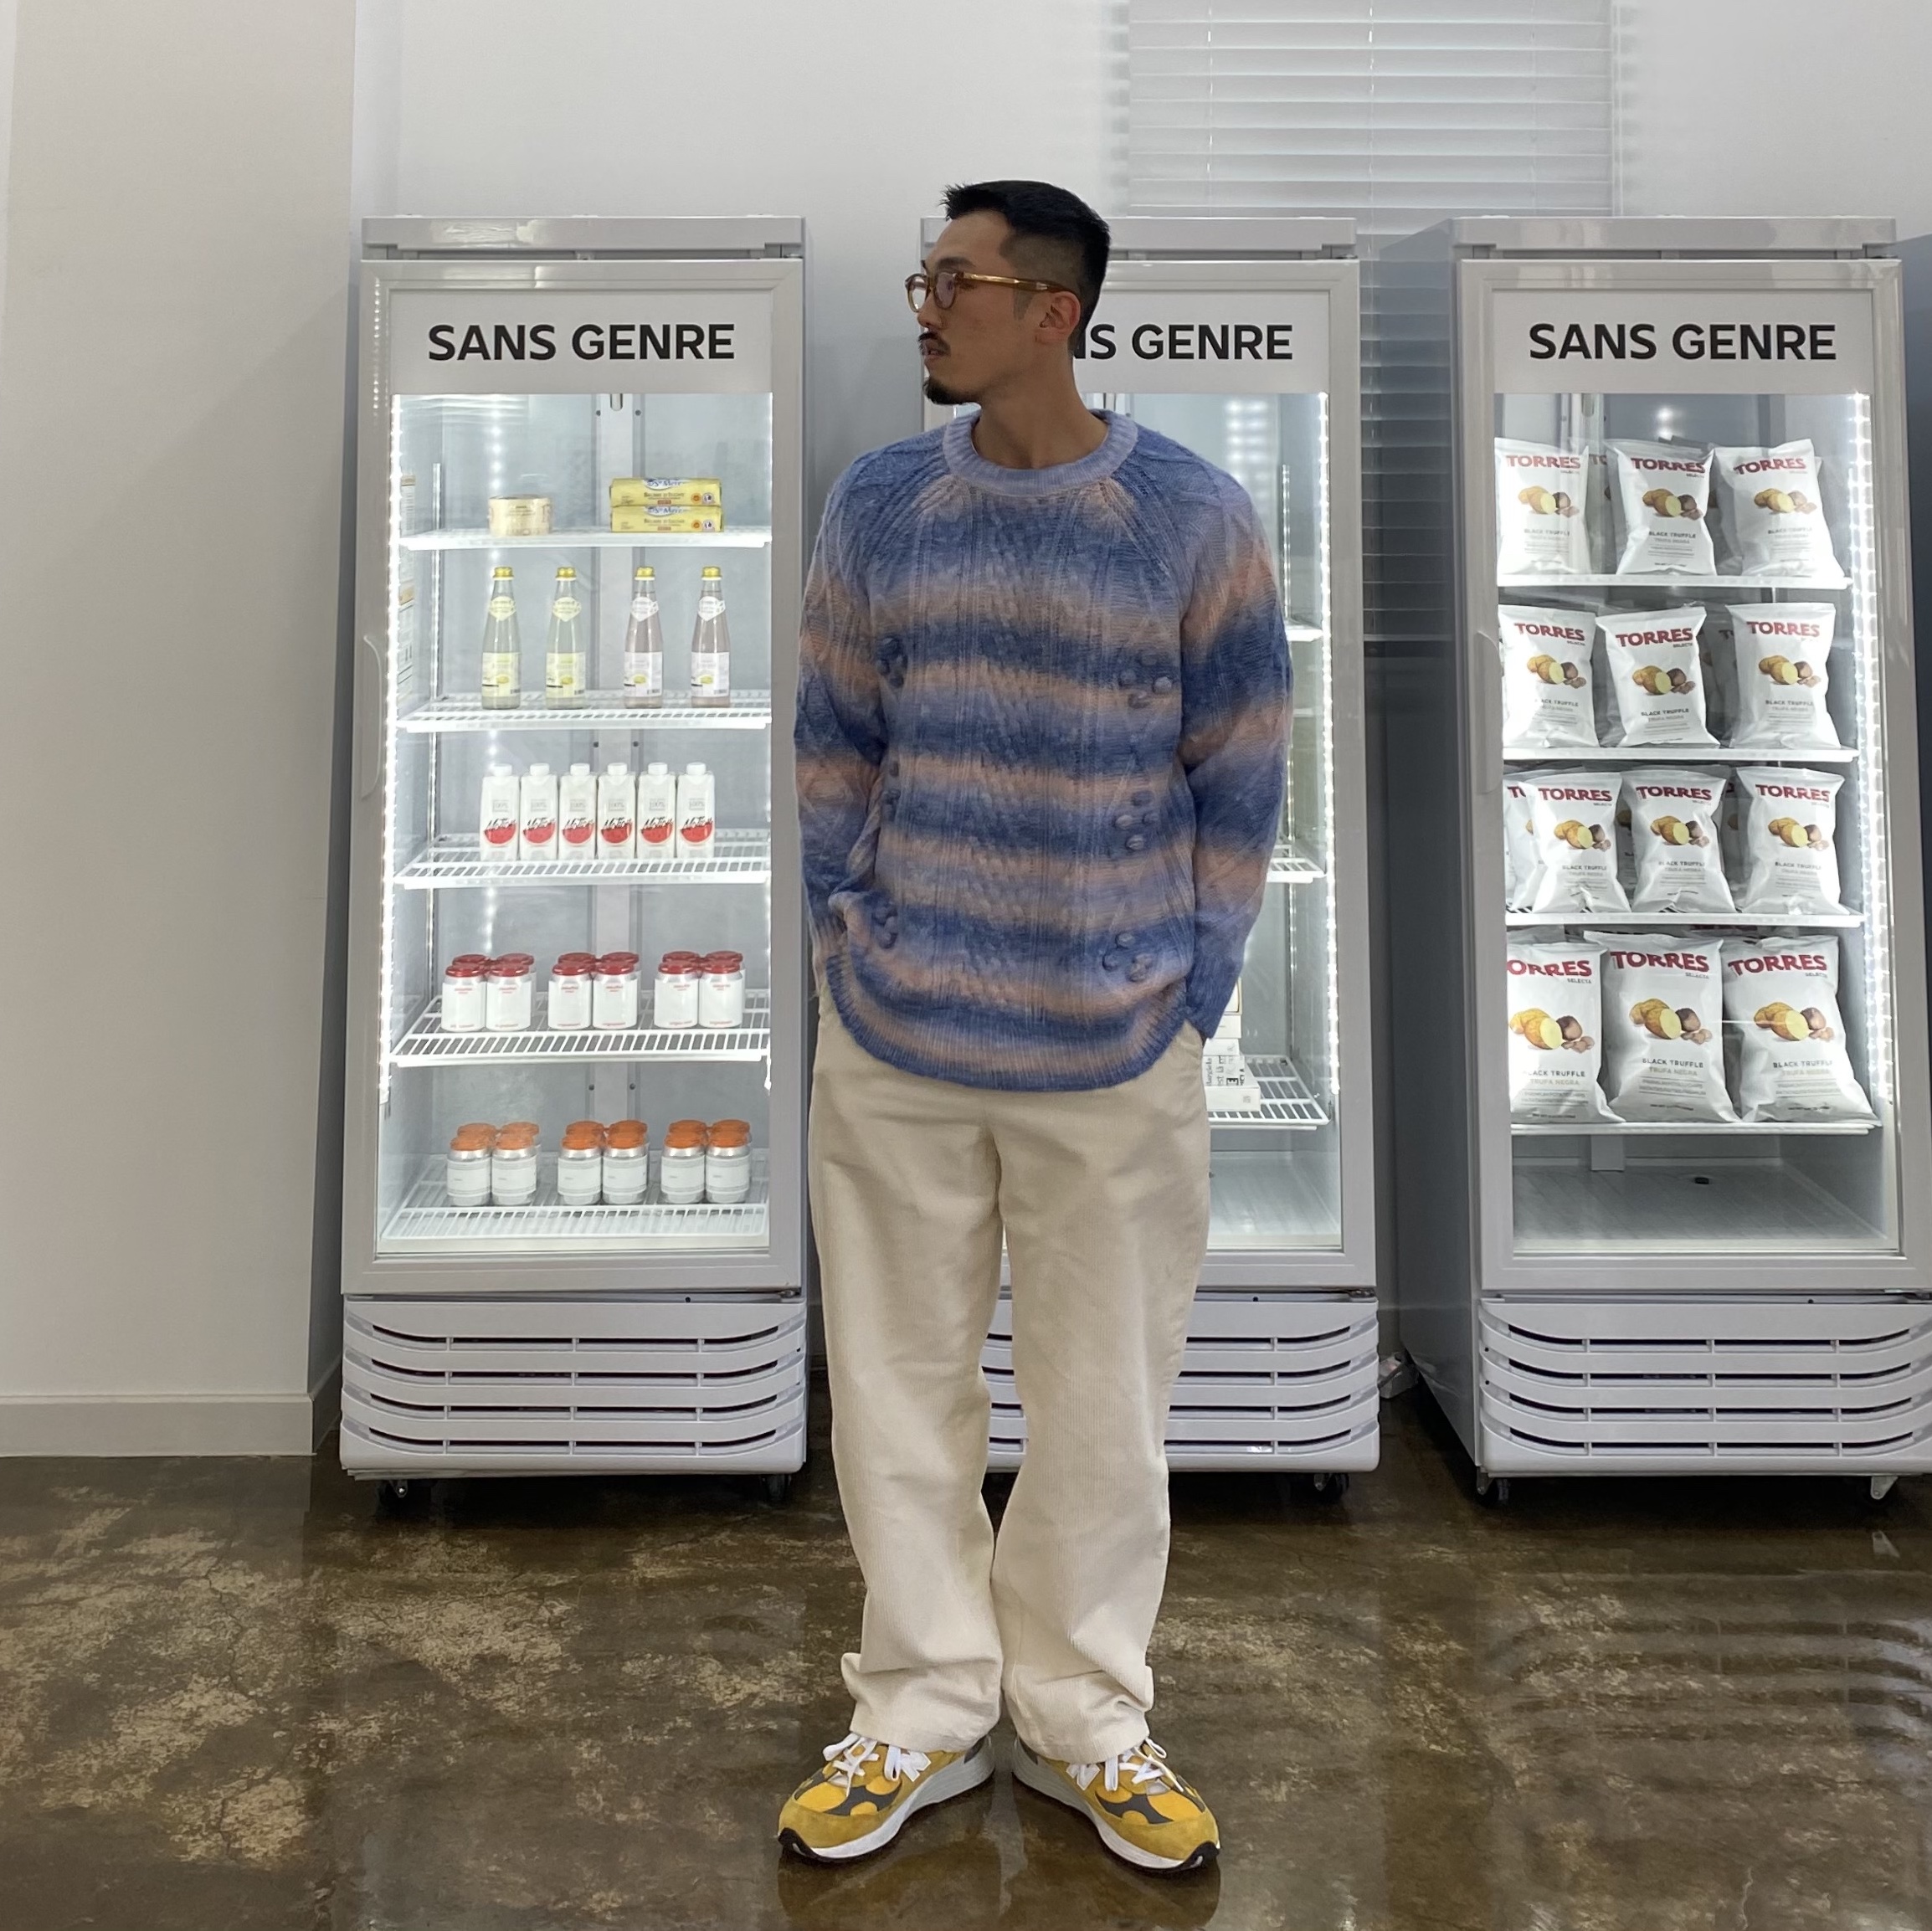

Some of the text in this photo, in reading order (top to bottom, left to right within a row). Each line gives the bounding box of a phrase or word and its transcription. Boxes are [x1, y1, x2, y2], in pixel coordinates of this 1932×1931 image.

[428, 324, 735, 361] SANS GENRE
[1132, 324, 1292, 360] GENRE
[1529, 323, 1837, 360] SANS GENRE
[1506, 455, 1580, 470] TORRES
[1631, 458, 1705, 474] TORRES
[1734, 458, 1806, 475] TORRES
[1514, 622, 1585, 641] TORRES
[1616, 628, 1693, 647] TORRES
[1746, 621, 1820, 637] TORRES
[1539, 788, 1612, 802] TORRES
[1636, 786, 1712, 800] TORRES
[1755, 784, 1830, 803] TORRES
[1507, 959, 1592, 977] ORRES
[1610, 951, 1709, 973] TORRES
[1728, 954, 1827, 977] TORRES
[1669, 1060, 1703, 1068] TRUFFLE
